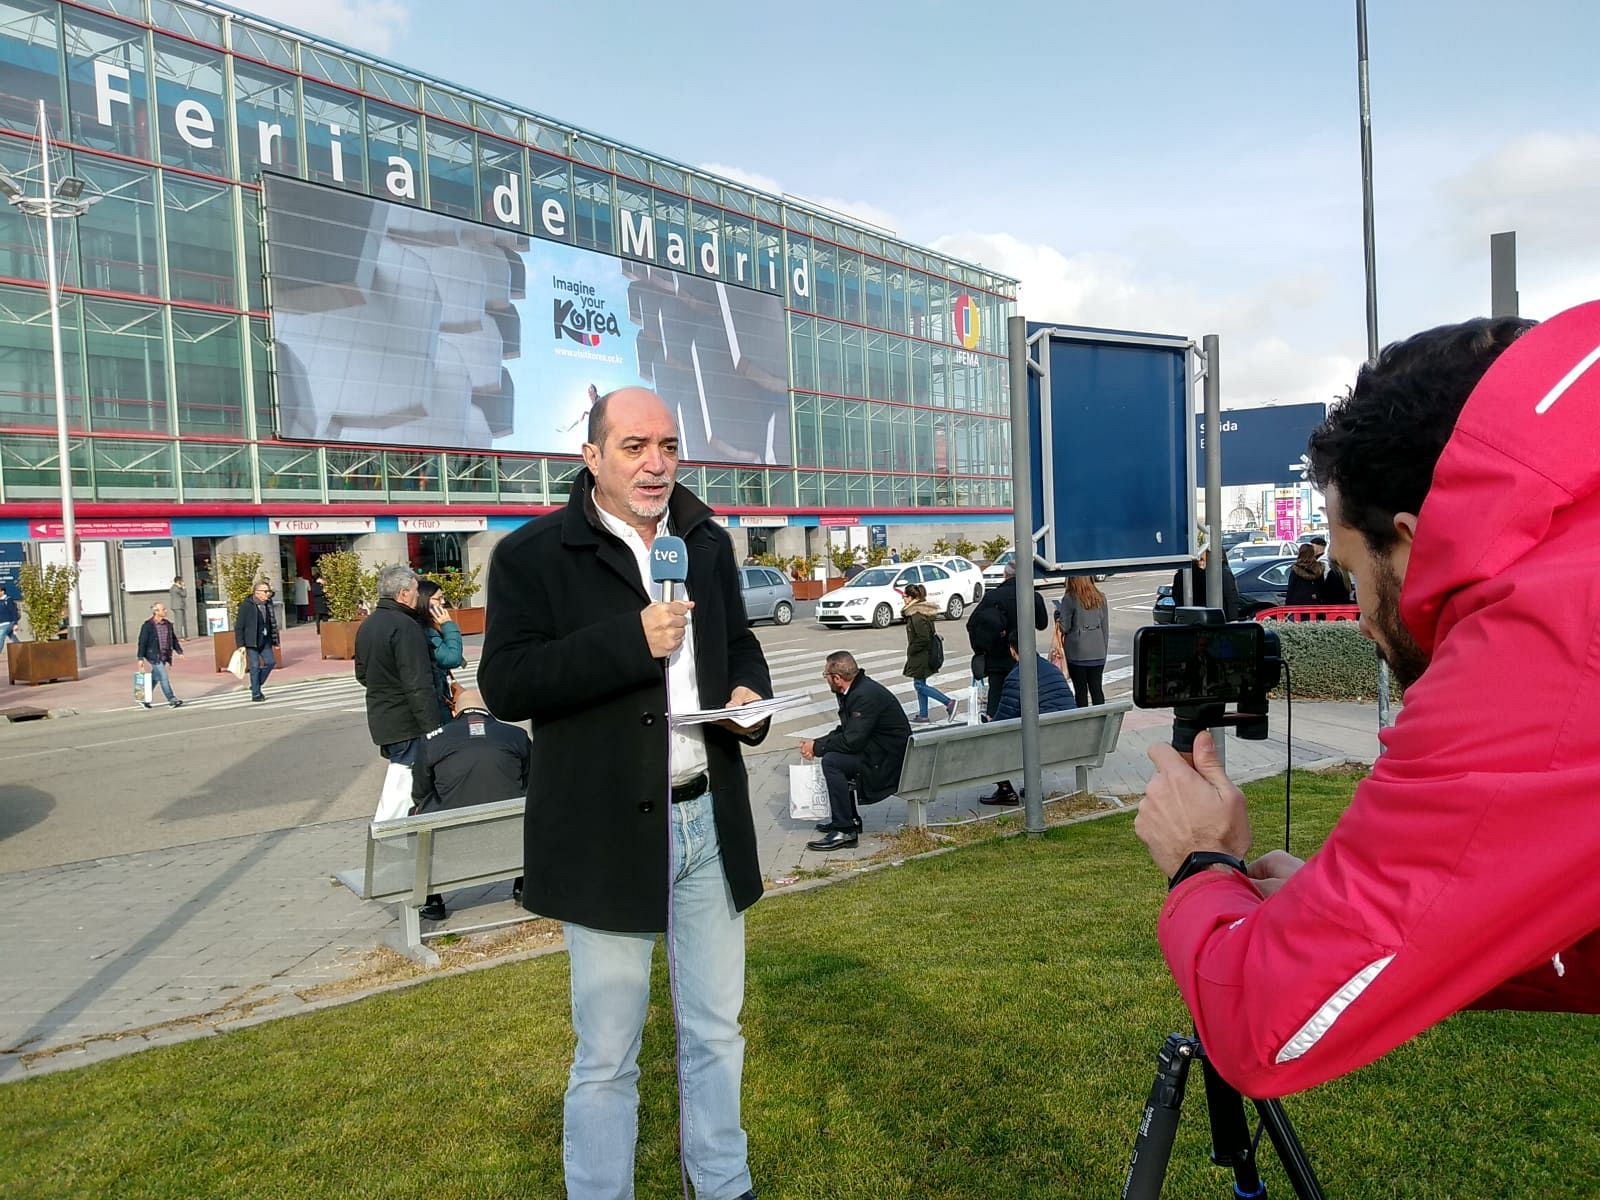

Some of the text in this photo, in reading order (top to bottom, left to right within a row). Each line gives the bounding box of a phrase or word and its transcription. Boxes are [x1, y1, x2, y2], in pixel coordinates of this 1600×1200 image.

[92, 60, 809, 298] Feria de Madrid
[552, 275, 596, 296] Imagine
[580, 296, 606, 309] your
[553, 298, 621, 347] Korea
[956, 350, 980, 367] IFEMA
[1199, 420, 1238, 434] Sida
[654, 548, 678, 563] tve
